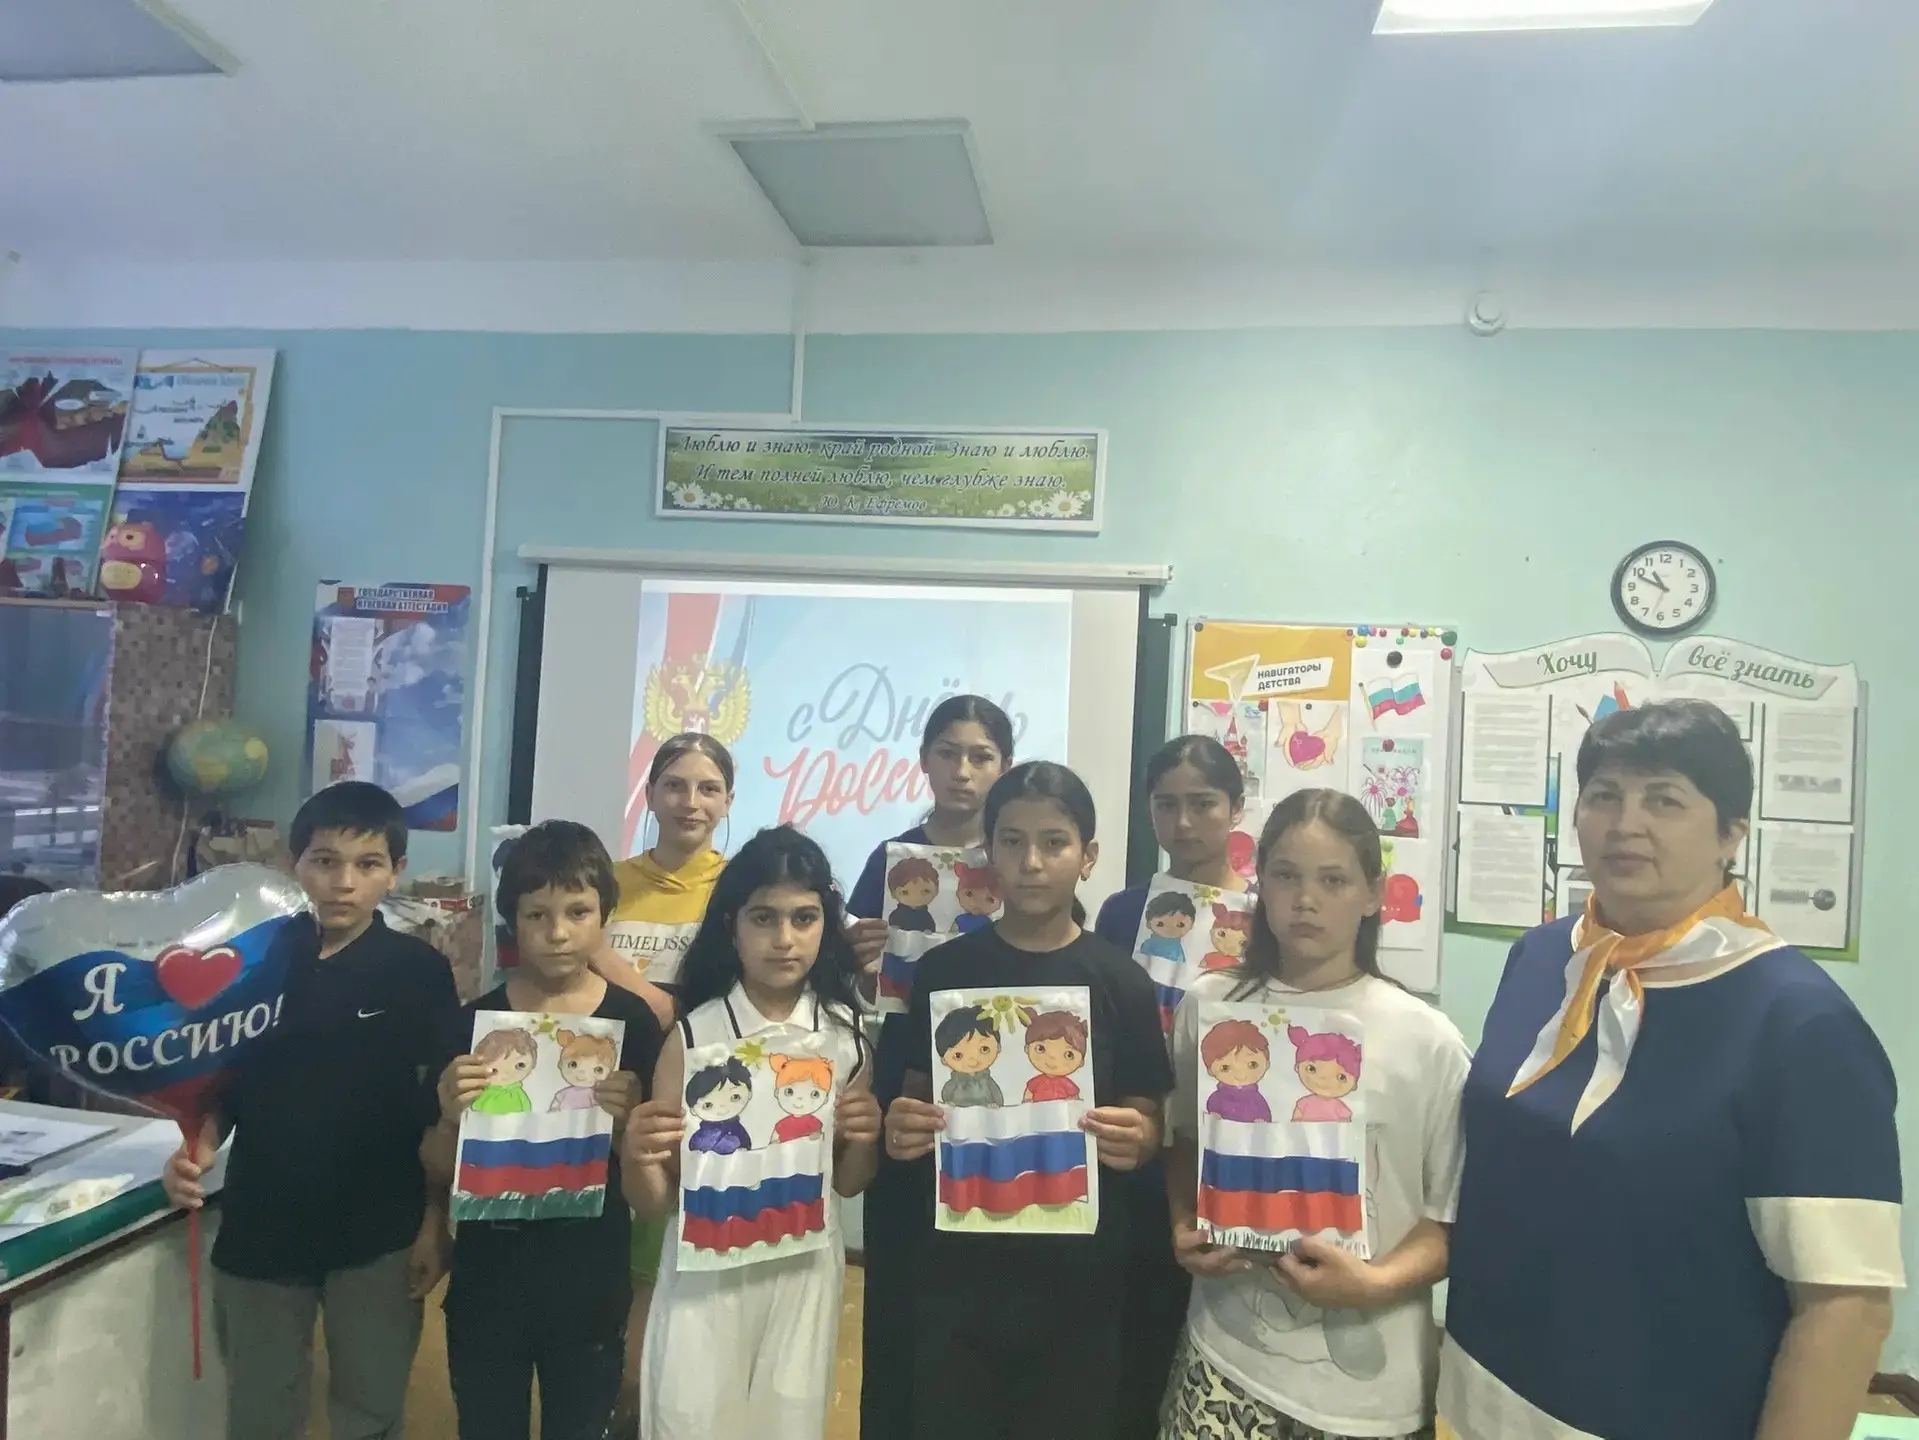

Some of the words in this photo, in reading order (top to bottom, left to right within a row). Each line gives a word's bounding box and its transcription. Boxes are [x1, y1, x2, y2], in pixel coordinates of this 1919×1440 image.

[676, 434, 741, 453] Люблю
[744, 439, 757, 453] и
[819, 438, 866, 461] край
[864, 435, 937, 461] родной.
[946, 440, 997, 459] Знаю
[1003, 444, 1015, 458] и
[1019, 439, 1090, 459] люблю.
[695, 462, 715, 481] И
[716, 467, 754, 482] тем
[760, 466, 823, 483] полней
[826, 464, 894, 488] люблю,
[901, 472, 936, 486] чем
[940, 467, 1009, 492] глубже
[1013, 473, 1067, 489] знаю.
[1645, 557, 1653, 567] 11
[1660, 553, 1672, 563] 12
[1680, 558, 1684, 568] 1
[1633, 567, 1645, 577] 10
[1687, 568, 1695, 578] 2
[1628, 582, 1636, 591] 9
[1690, 583, 1698, 593] 3
[1630, 596, 1639, 605] 8
[1684, 598, 1693, 607] 4
[1641, 607, 1649, 617] 7
[1656, 612, 1664, 621] 6
[1672, 608, 1680, 618] 5
[1258, 663, 1321, 679] НАВИГАТОРЫ
[1537, 651, 1597, 675] Хочу
[1688, 644, 1731, 671] всё
[1730, 659, 1815, 690] знать
[1258, 677, 1301, 691] ДЕТСТВА
[72, 962, 127, 1021] Я
[50, 993, 284, 1075] РОССИЮ!
